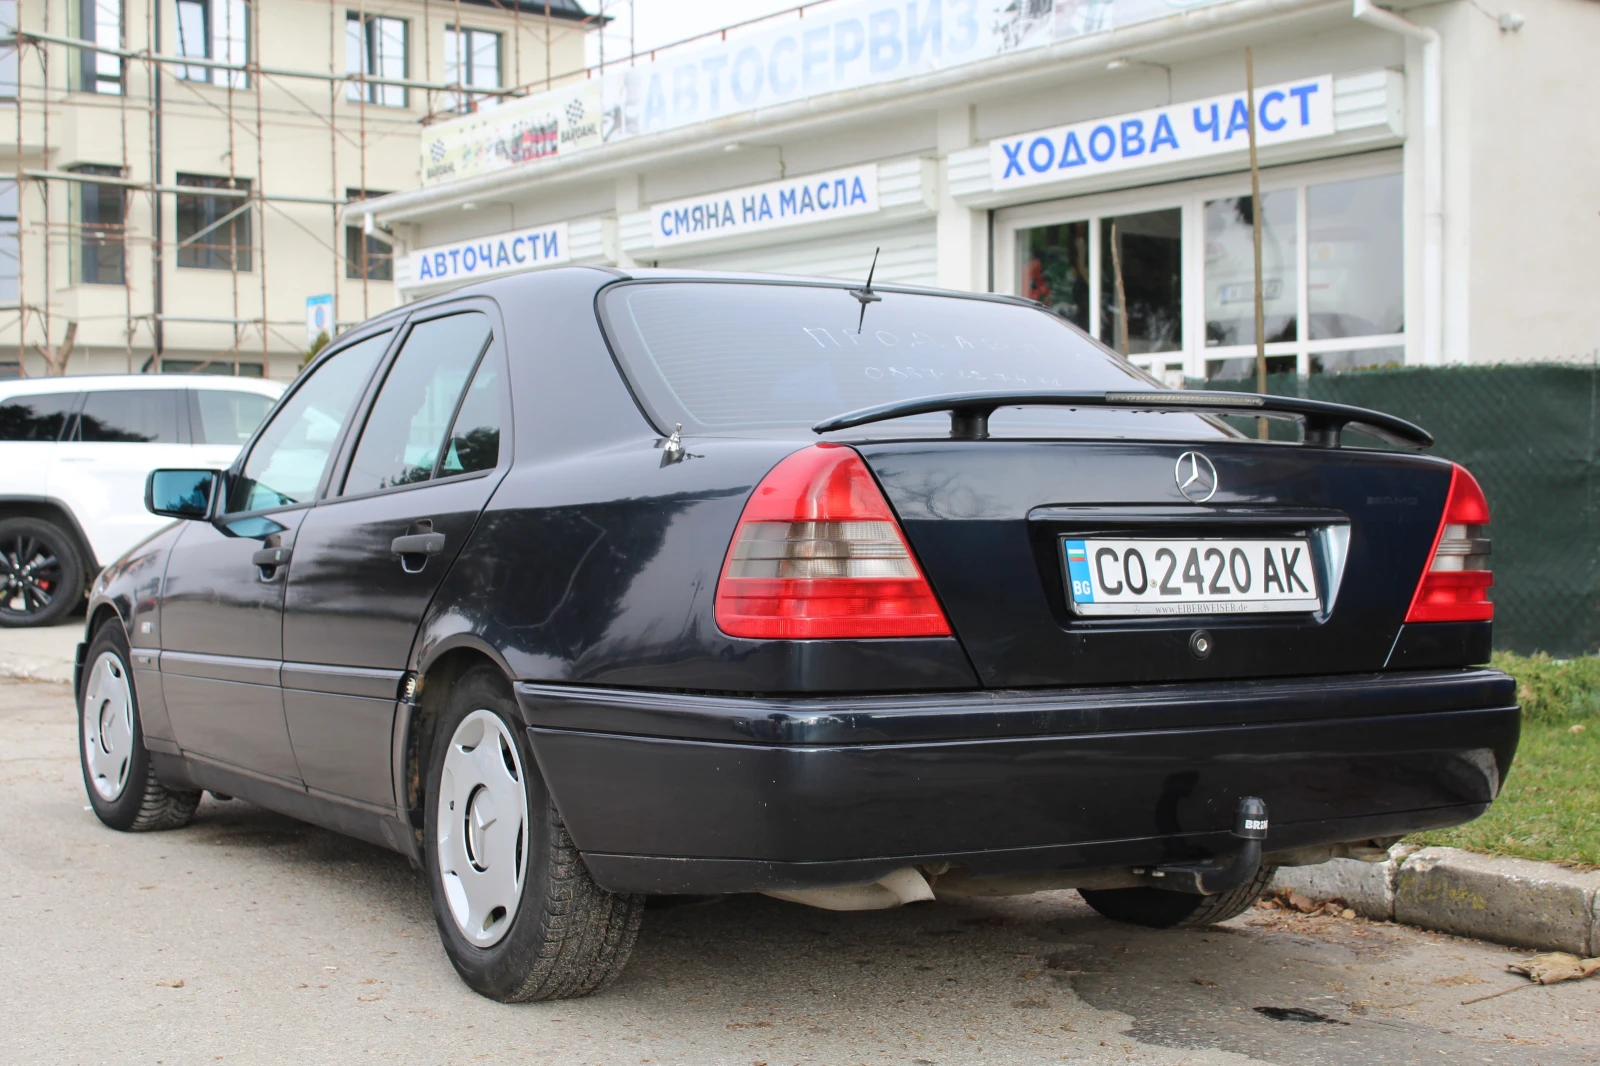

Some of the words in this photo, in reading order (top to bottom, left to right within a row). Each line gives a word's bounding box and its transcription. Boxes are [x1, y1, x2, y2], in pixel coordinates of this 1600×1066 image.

[641, 0, 981, 131] АВТОСЕРВИЗ
[1001, 112, 1180, 181] ХОДОВА
[1192, 82, 1320, 143] ЧАСТ
[660, 201, 736, 238] СМЯНА
[742, 195, 773, 222] НА
[778, 175, 867, 217] МАСЛА
[418, 230, 560, 281] АВТОЧАСТИ
[1073, 580, 1091, 597] BG
[1094, 546, 1148, 596] CO
[1154, 546, 1252, 596] 2420
[1263, 546, 1310, 594] AK
[1155, 602, 1249, 614] www.EIBERWEISER.de
